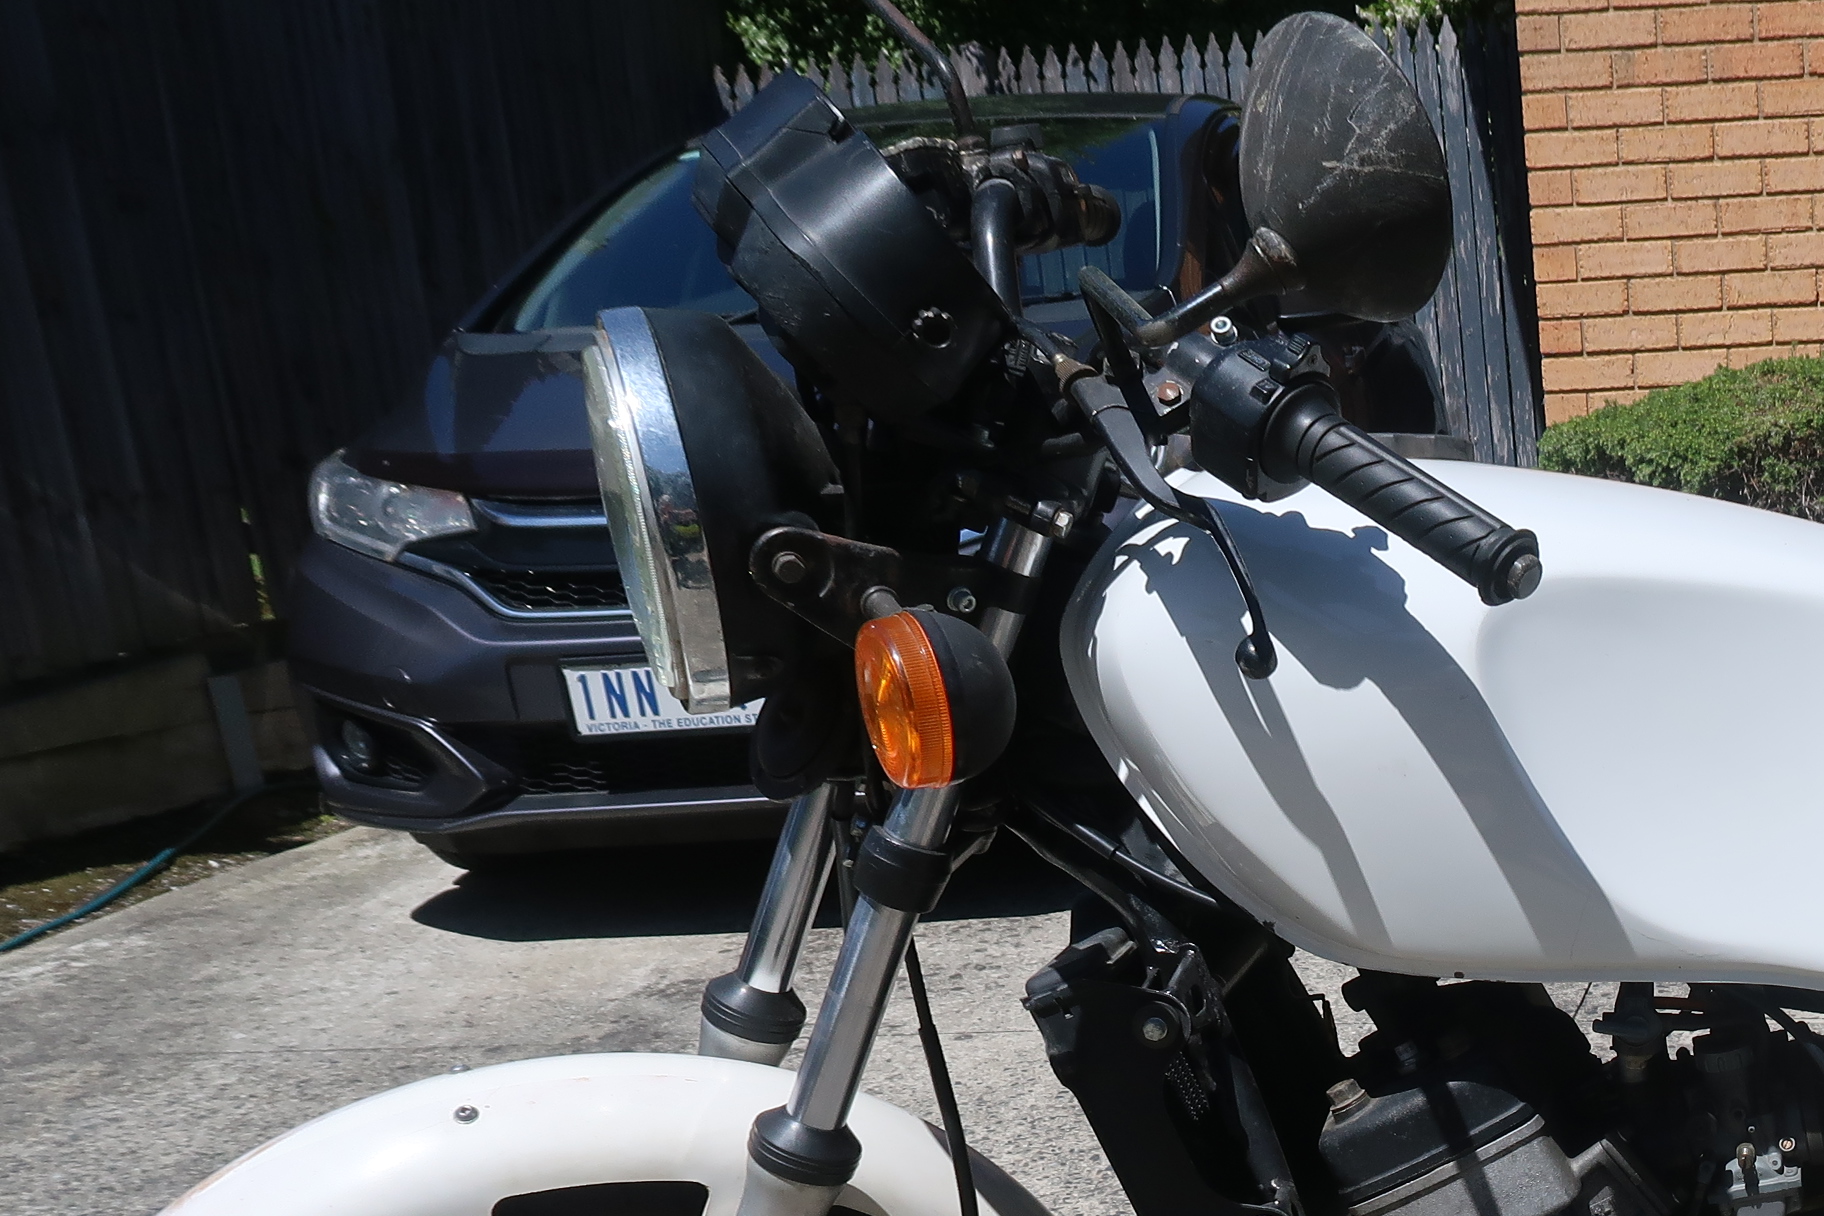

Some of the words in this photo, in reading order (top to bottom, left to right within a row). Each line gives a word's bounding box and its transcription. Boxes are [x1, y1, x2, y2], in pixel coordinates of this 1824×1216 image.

[576, 668, 660, 721] 1NN
[585, 720, 641, 733] VICTORIA
[651, 717, 674, 729] THE
[677, 713, 742, 727] EDUCATION
